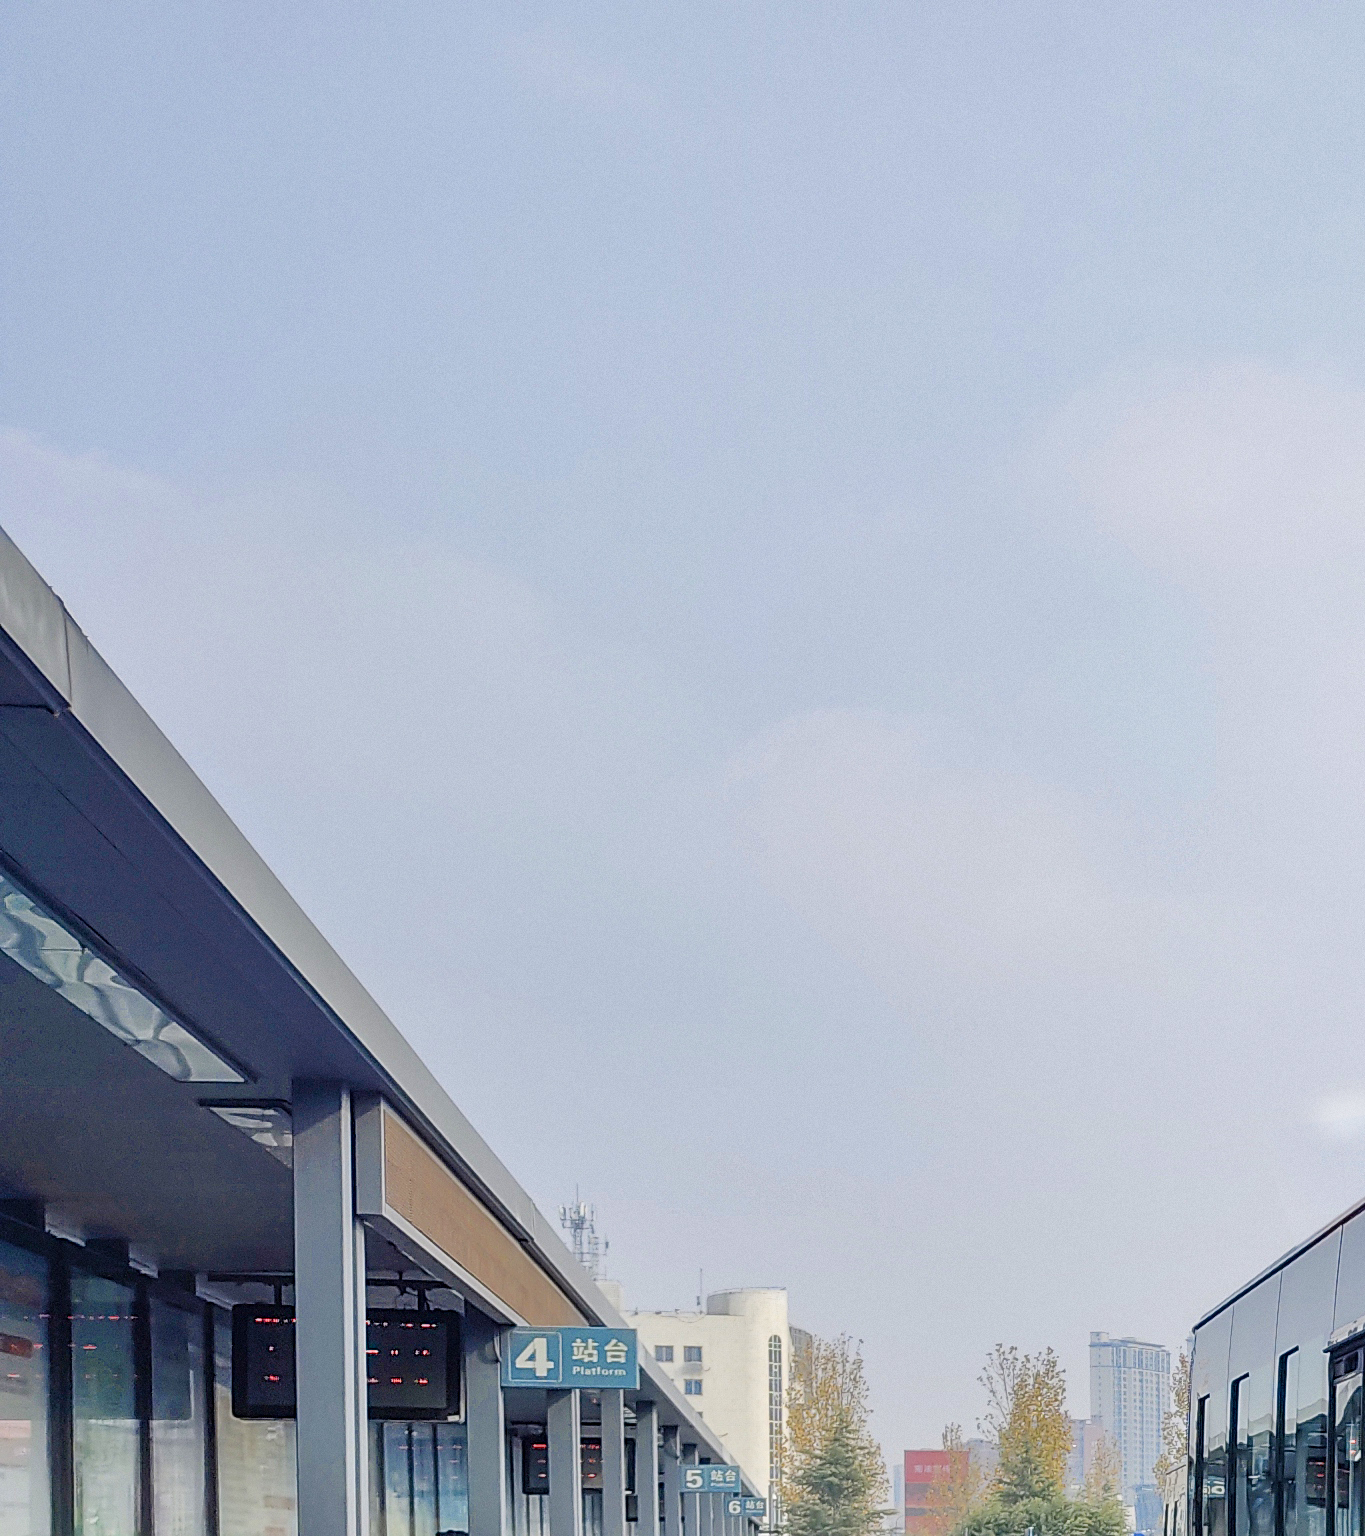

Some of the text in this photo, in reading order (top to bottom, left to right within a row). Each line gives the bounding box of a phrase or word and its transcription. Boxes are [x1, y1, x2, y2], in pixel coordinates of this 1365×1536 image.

[514, 1337, 629, 1377] 4 站台
[572, 1365, 627, 1376] Platform
[685, 1469, 737, 1488] 5 站台
[728, 1500, 741, 1514] 6
